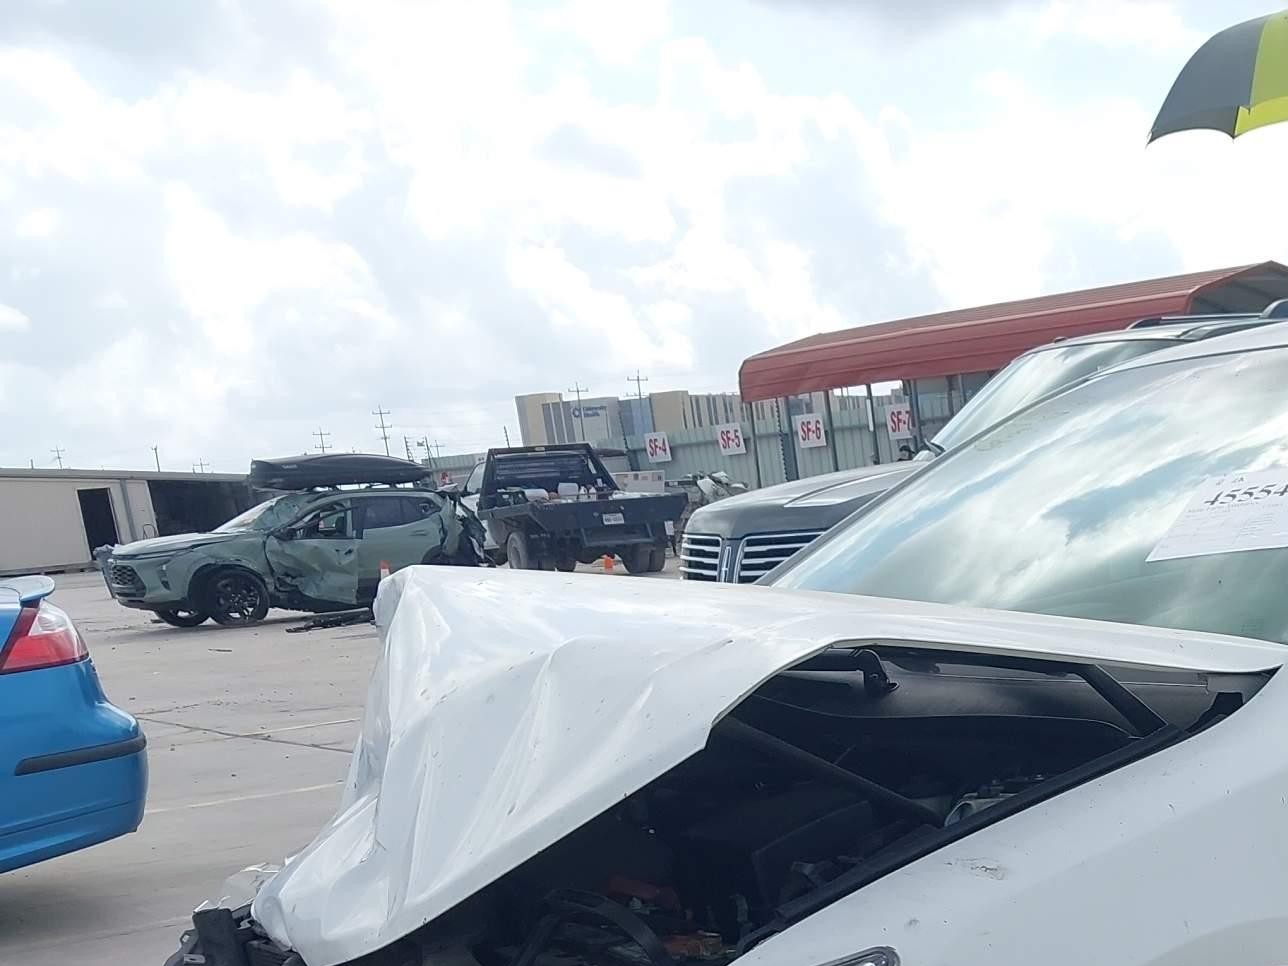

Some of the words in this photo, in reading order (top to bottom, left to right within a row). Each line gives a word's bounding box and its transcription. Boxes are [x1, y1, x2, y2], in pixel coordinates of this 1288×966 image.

[721, 429, 741, 449] SF-5
[801, 420, 821, 441] SF-6
[649, 438, 667, 457] SF-4
